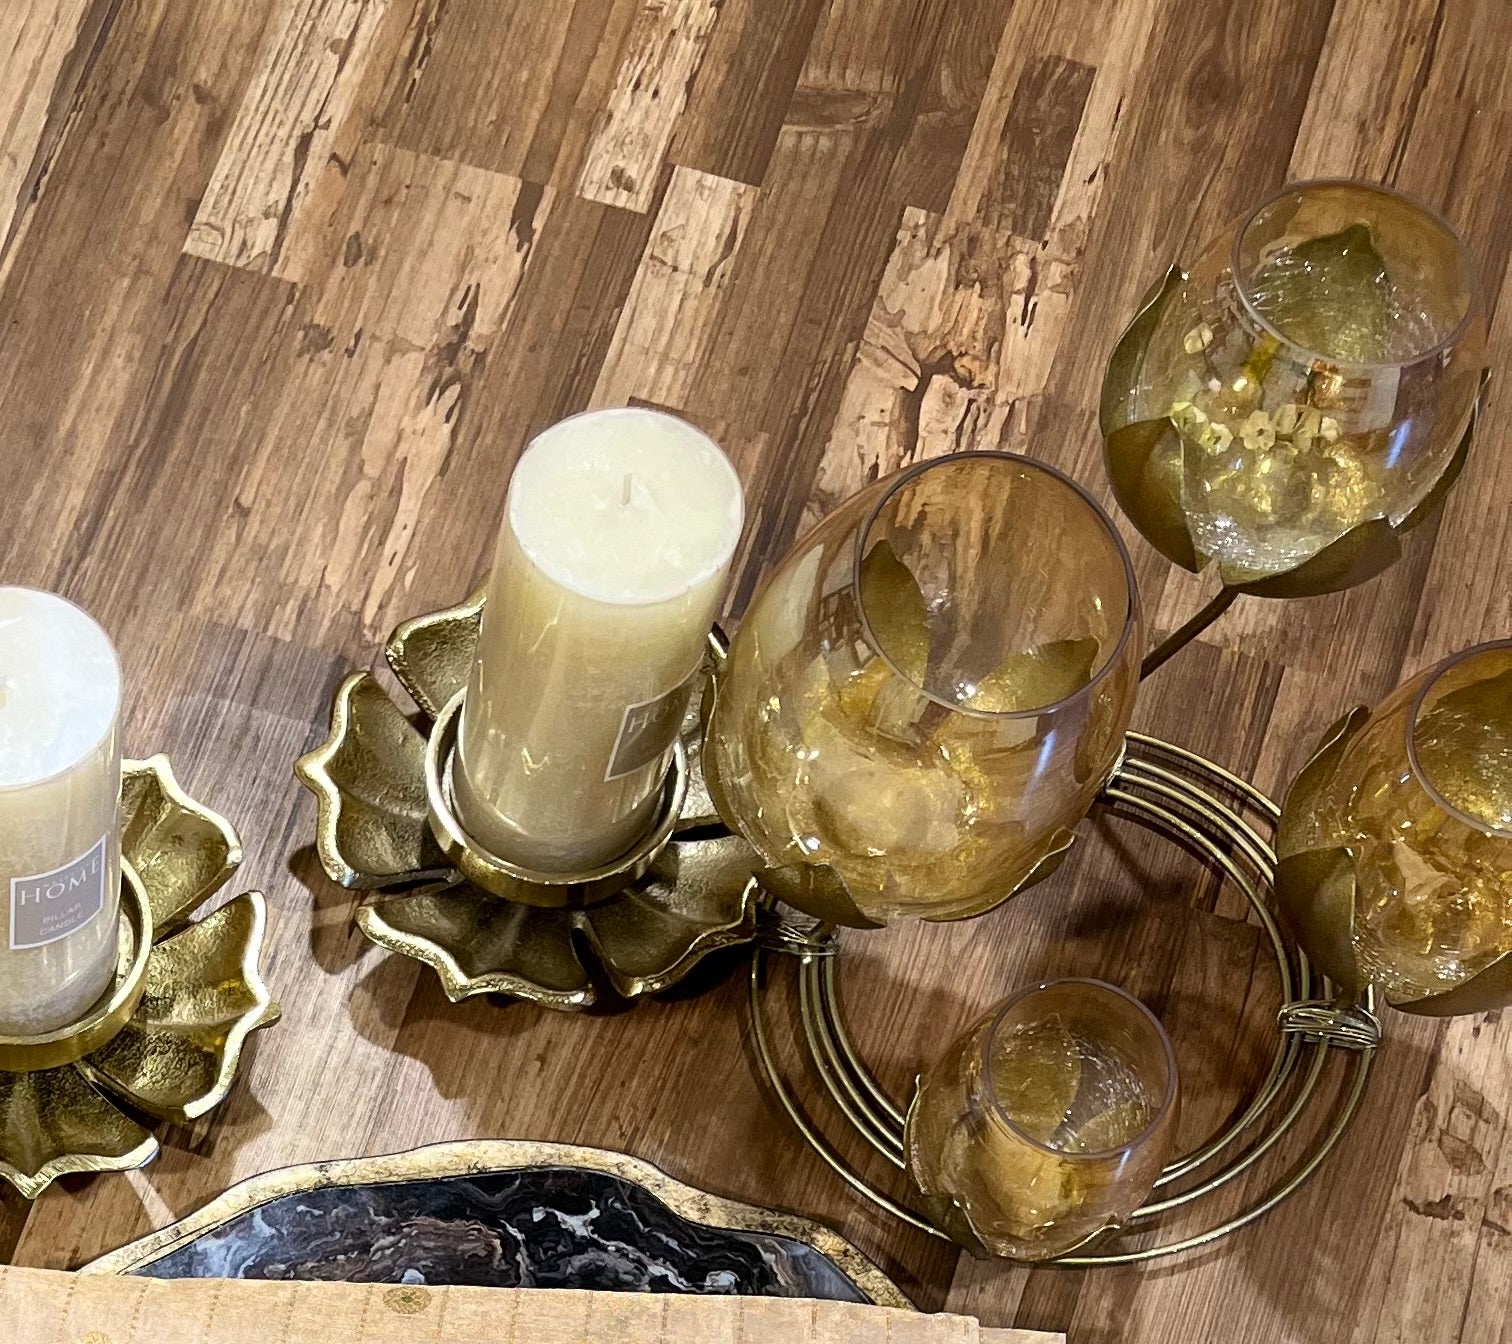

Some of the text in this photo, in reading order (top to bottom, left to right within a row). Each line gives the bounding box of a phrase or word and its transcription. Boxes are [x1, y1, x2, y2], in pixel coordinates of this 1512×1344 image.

[20, 856, 99, 905] HOME
[39, 912, 84, 936] CANDLE
[43, 903, 82, 924] PILLAR
